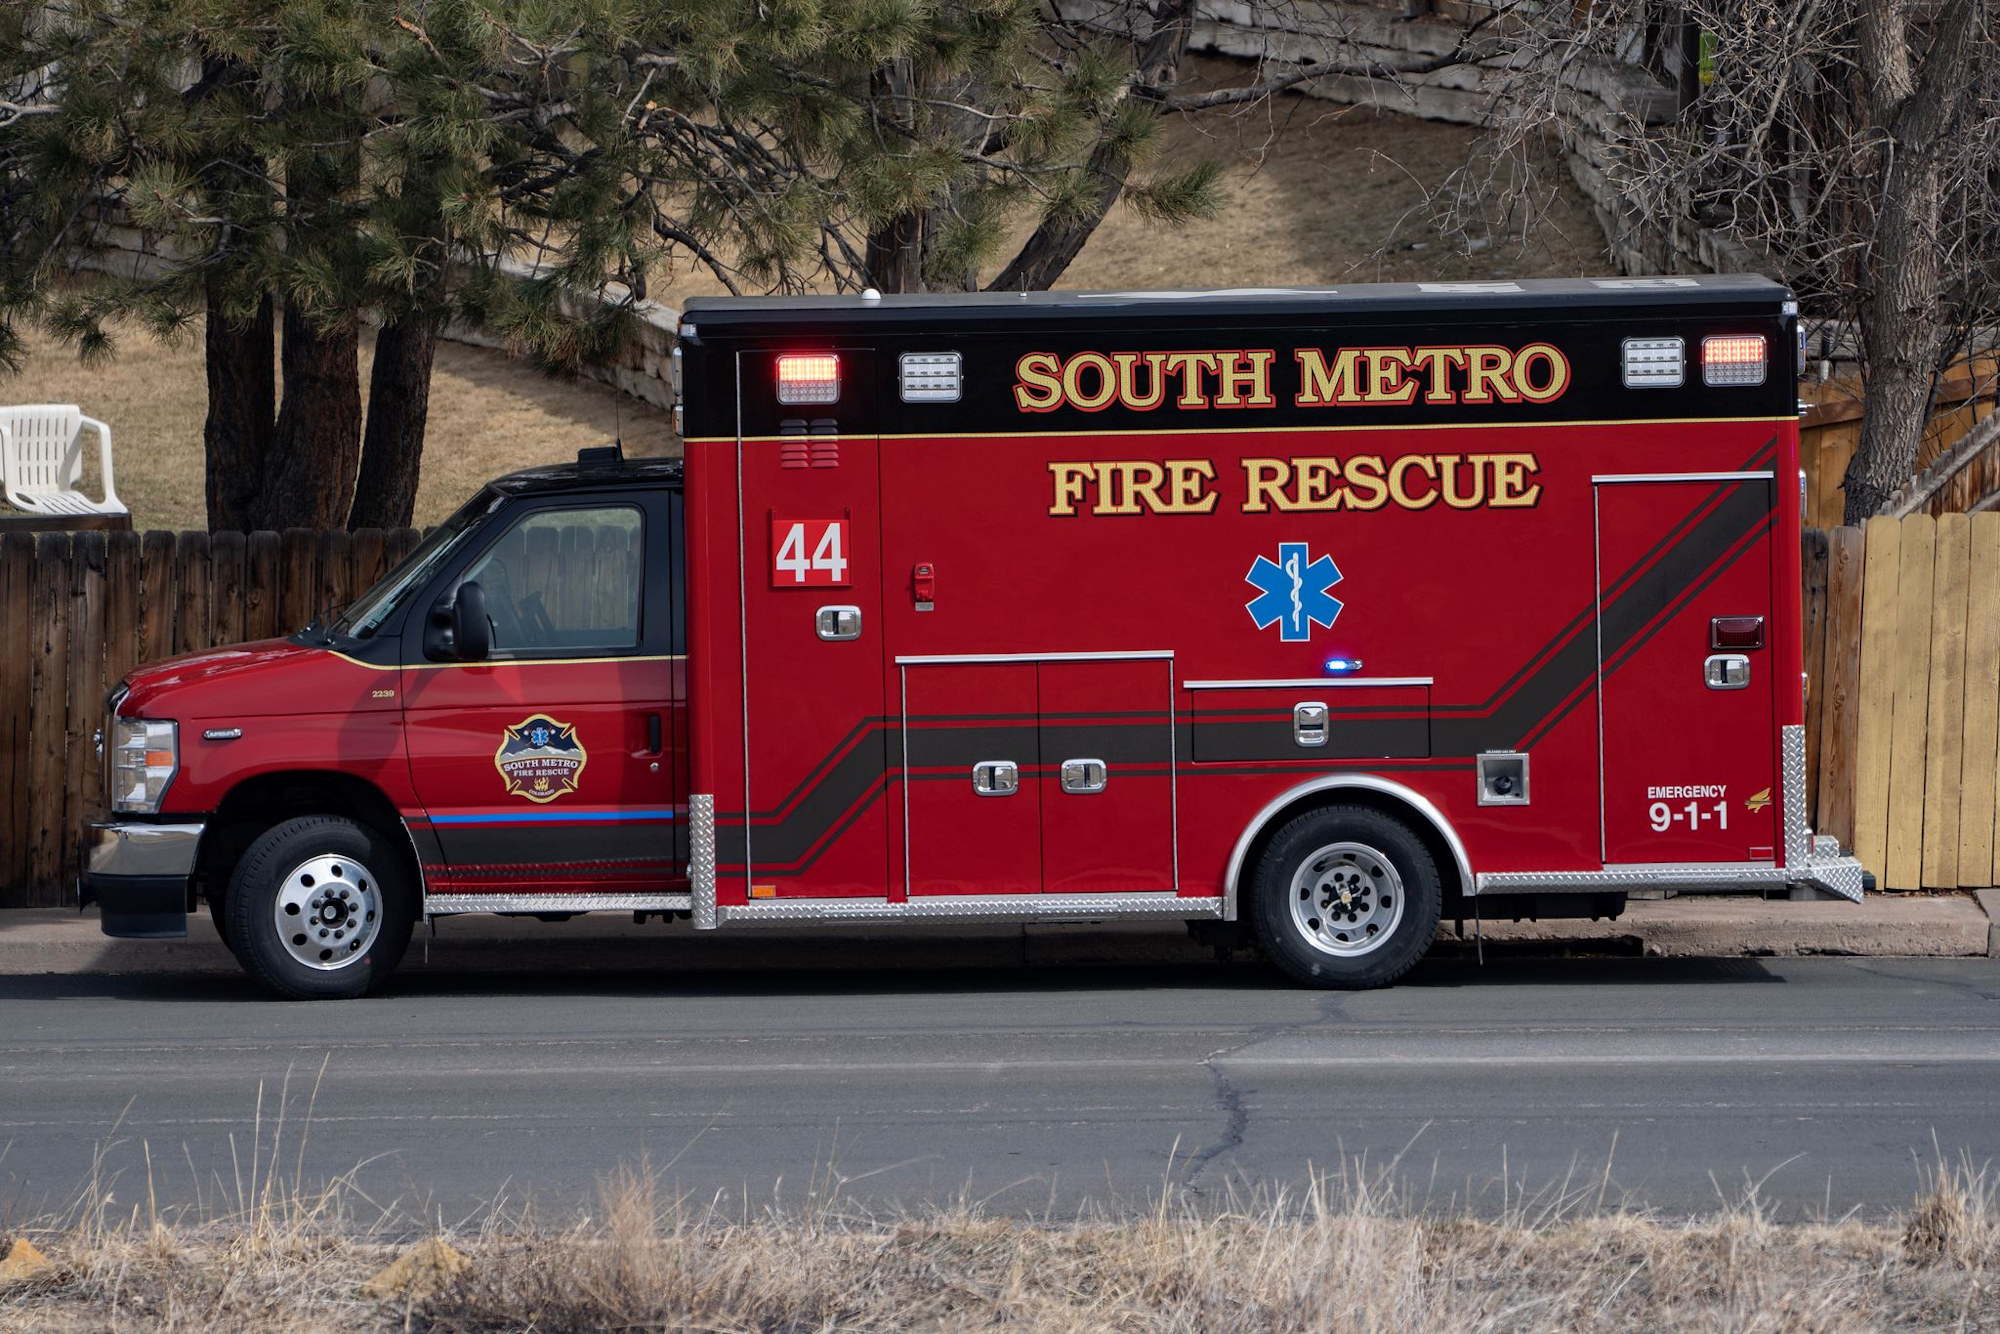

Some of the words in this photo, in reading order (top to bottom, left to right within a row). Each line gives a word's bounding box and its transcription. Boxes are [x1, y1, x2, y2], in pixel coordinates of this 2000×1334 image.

[1013, 350, 1276, 412] SOUTH
[1295, 342, 1571, 406] METRO
[1047, 458, 1220, 517] FIRE
[1240, 452, 1544, 513] RESCUE
[776, 522, 847, 582] 44
[372, 689, 395, 698] 2239
[503, 760, 539, 772] SOUTH
[541, 759, 578, 769] METRO
[513, 769, 534, 777] FIRE
[536, 768, 570, 776] RESCUE
[528, 788, 555, 796] COLORADO
[1647, 785, 1727, 799] EMERGENCY
[1648, 800, 1728, 832] 9-1-1
